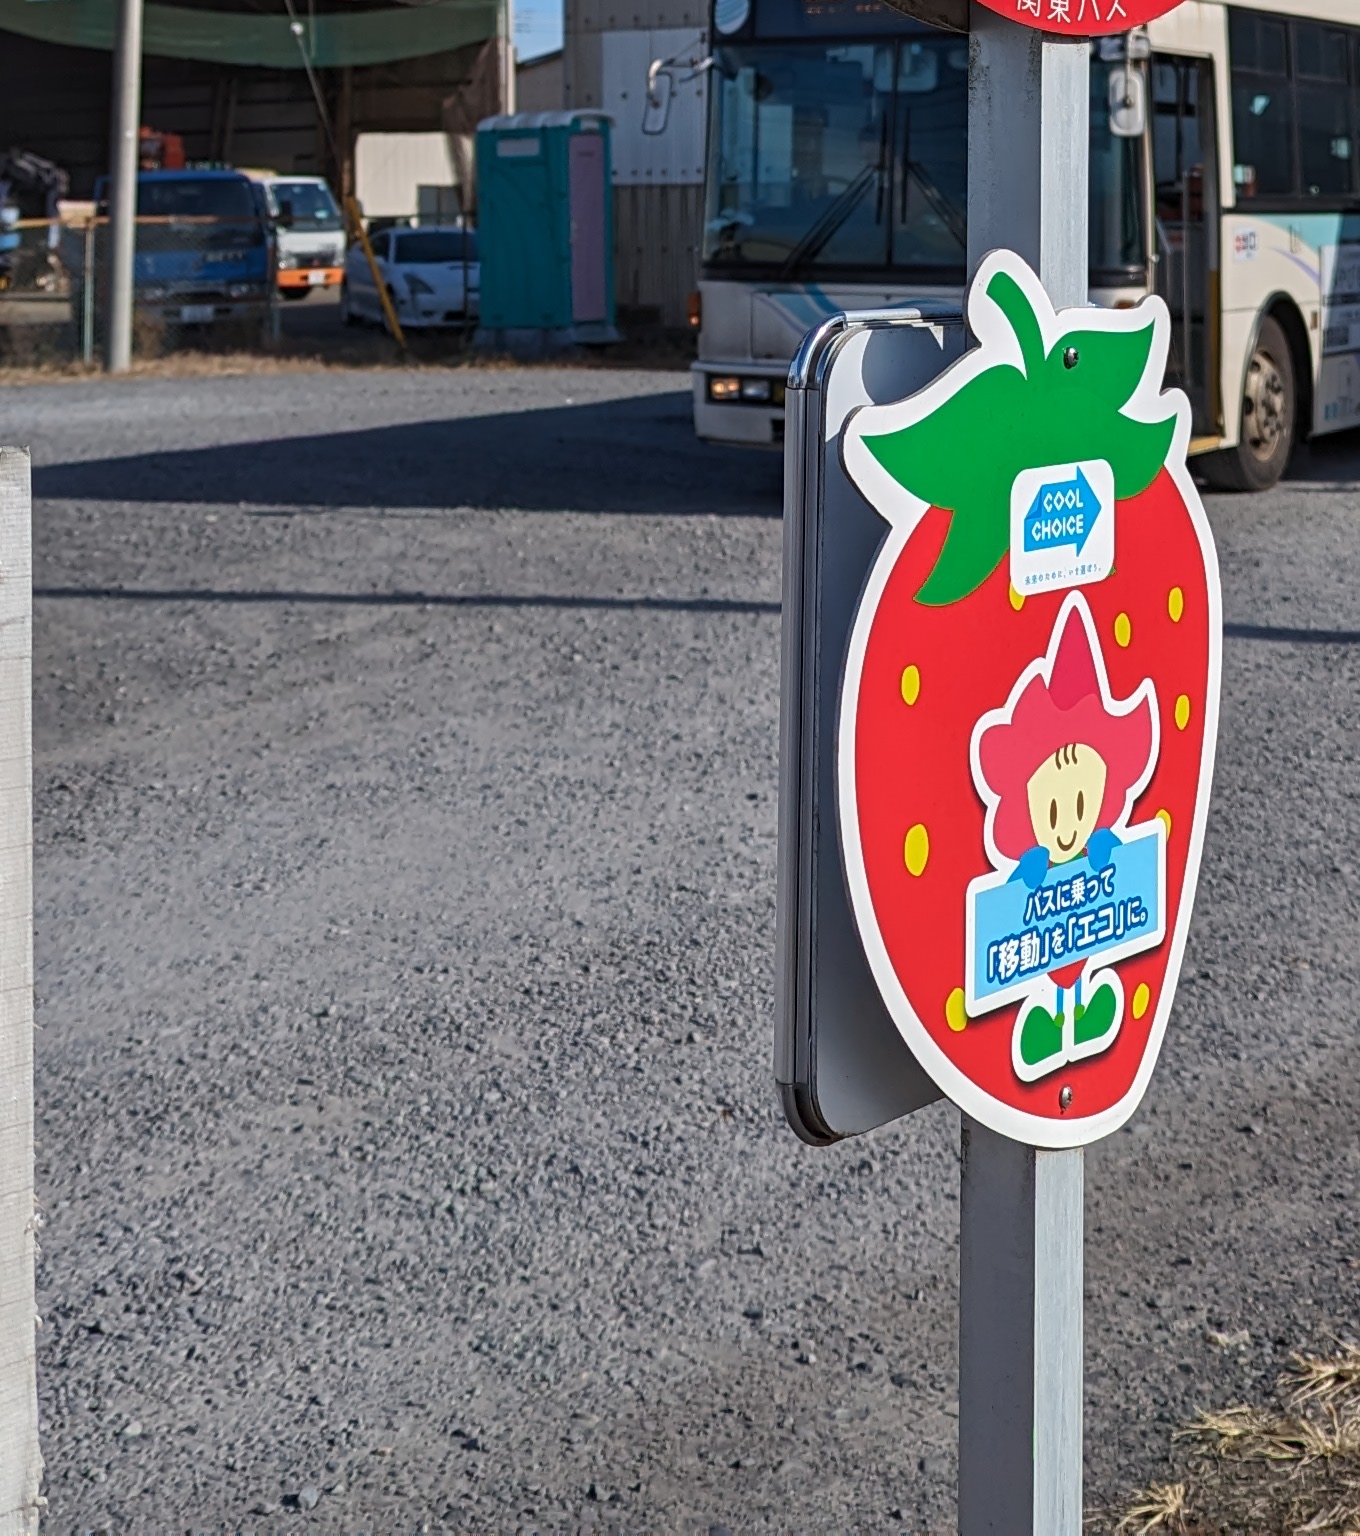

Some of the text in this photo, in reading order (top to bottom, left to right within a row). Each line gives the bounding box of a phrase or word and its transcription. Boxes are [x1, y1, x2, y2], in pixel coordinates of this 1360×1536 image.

[1043, 487, 1084, 513] COOL
[1031, 513, 1084, 541] CHOICE
[1025, 867, 1114, 922] バスに乗って
[989, 899, 1147, 981] 「移動」を「エコ」に。
